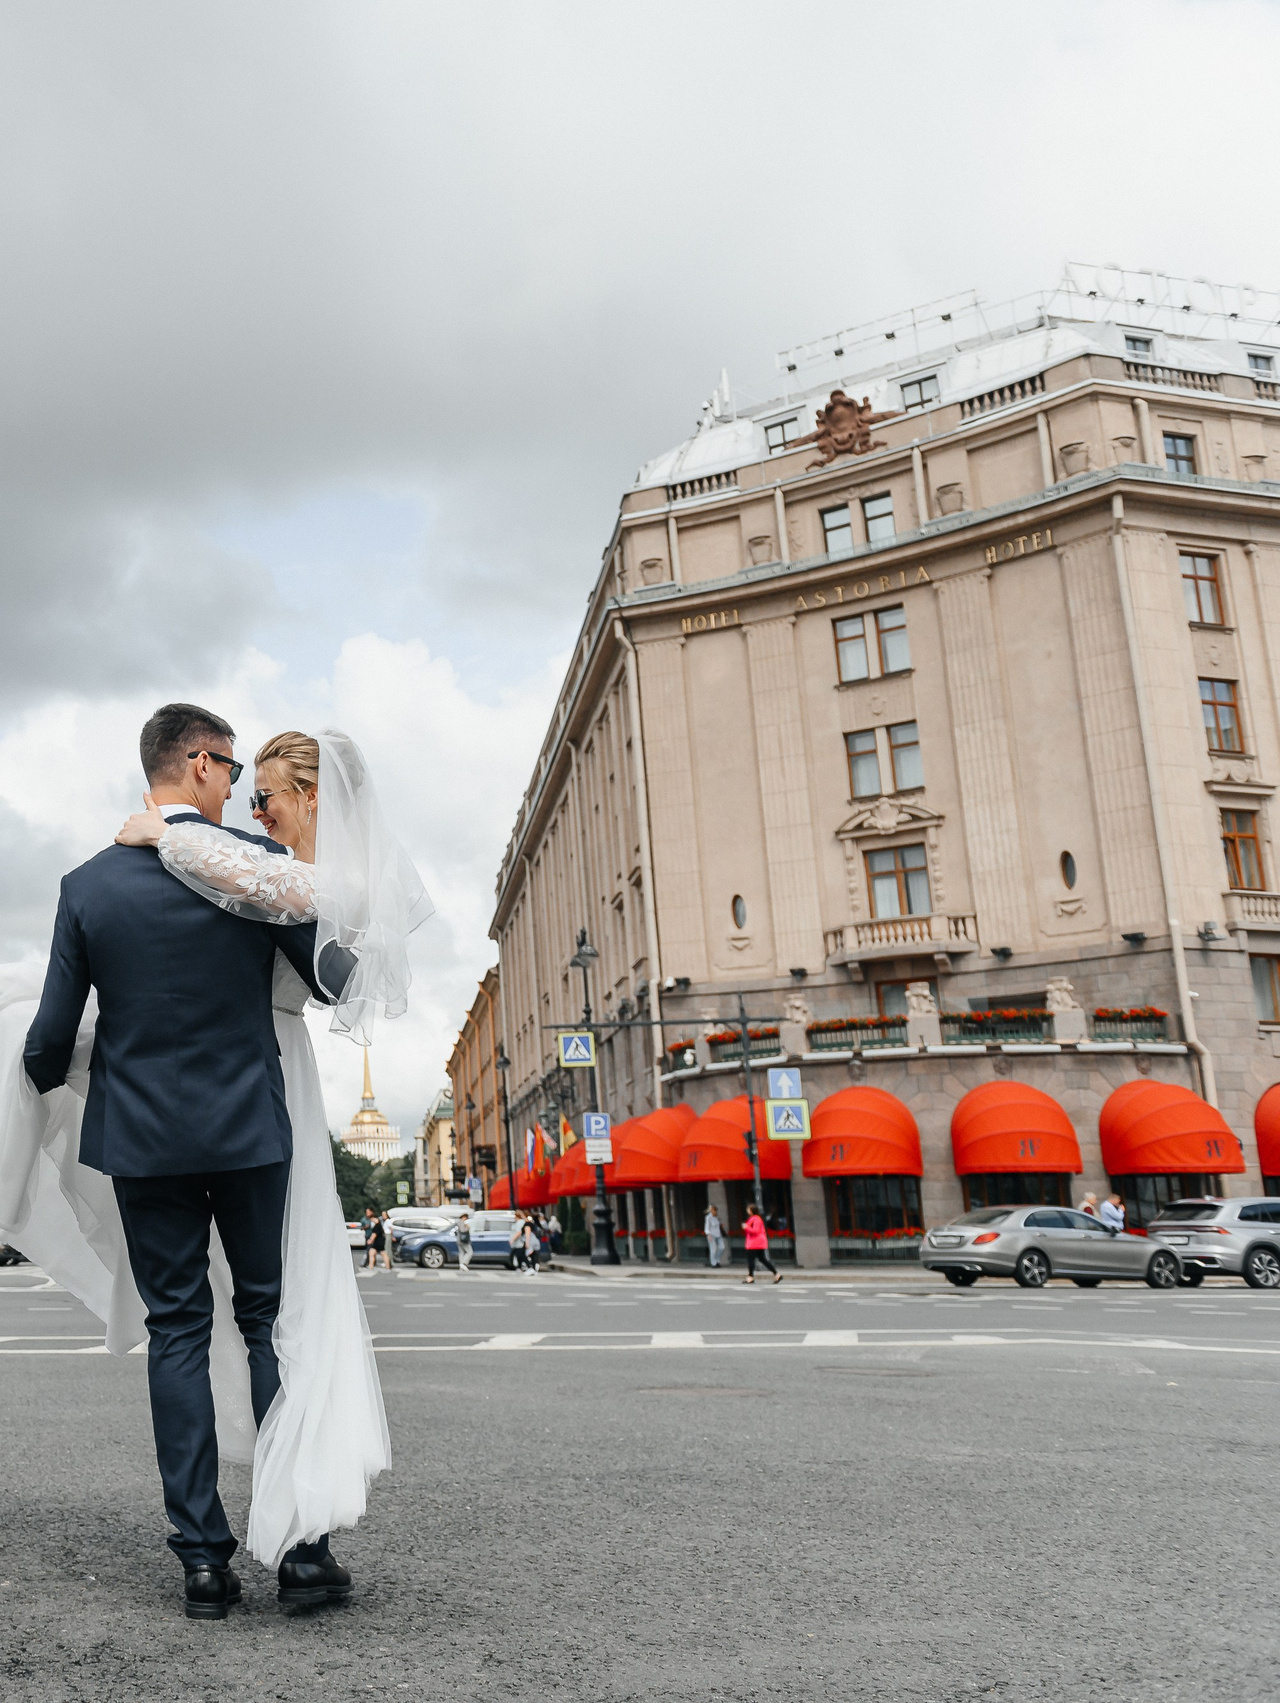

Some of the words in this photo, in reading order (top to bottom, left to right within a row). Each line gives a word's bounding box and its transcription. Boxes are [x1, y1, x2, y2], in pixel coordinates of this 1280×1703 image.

[1057, 257, 1280, 318] АСТОР
[681, 608, 740, 633] HOTEL
[794, 565, 931, 610] ASTORIA
[985, 529, 1052, 563] HOTEL
[590, 1116, 605, 1136] P
